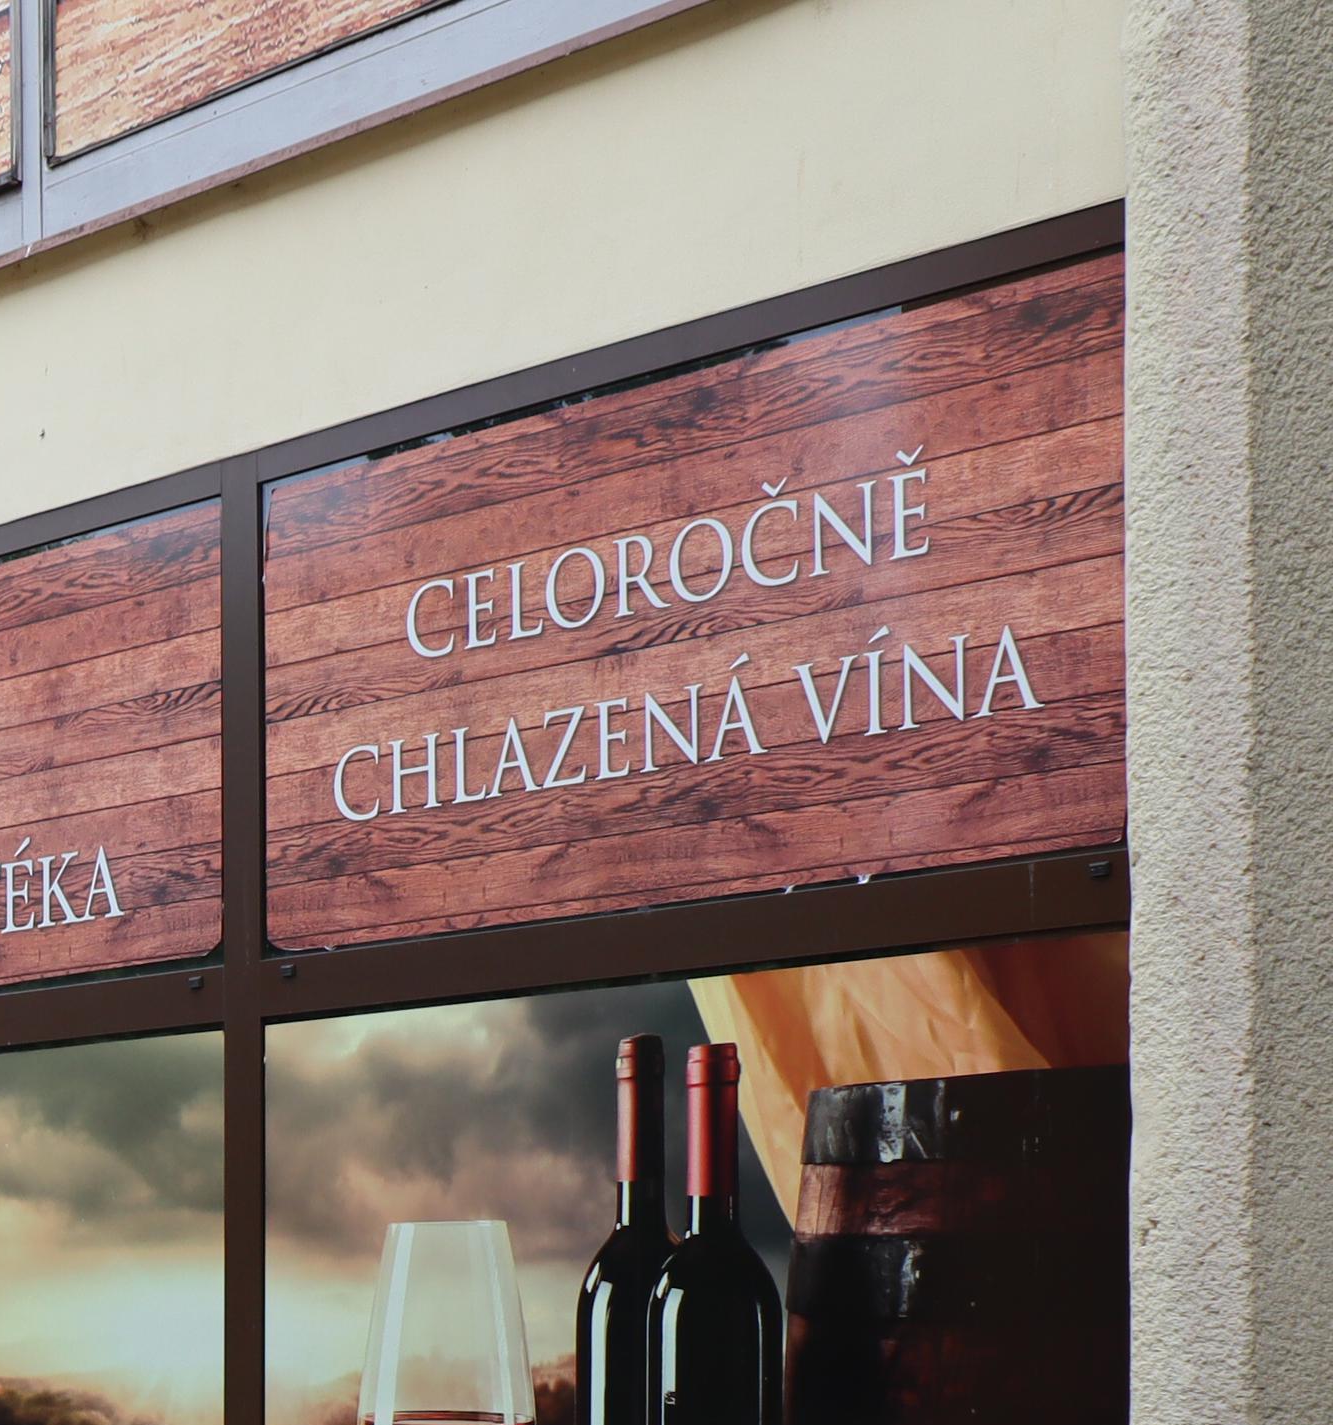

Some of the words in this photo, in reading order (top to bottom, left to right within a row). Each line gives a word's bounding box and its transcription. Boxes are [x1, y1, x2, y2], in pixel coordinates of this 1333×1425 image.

[406, 444, 931, 659] CELOROČNĚ
[333, 651, 770, 823] CHLAZENÁ
[791, 623, 1047, 745] VÍNA
